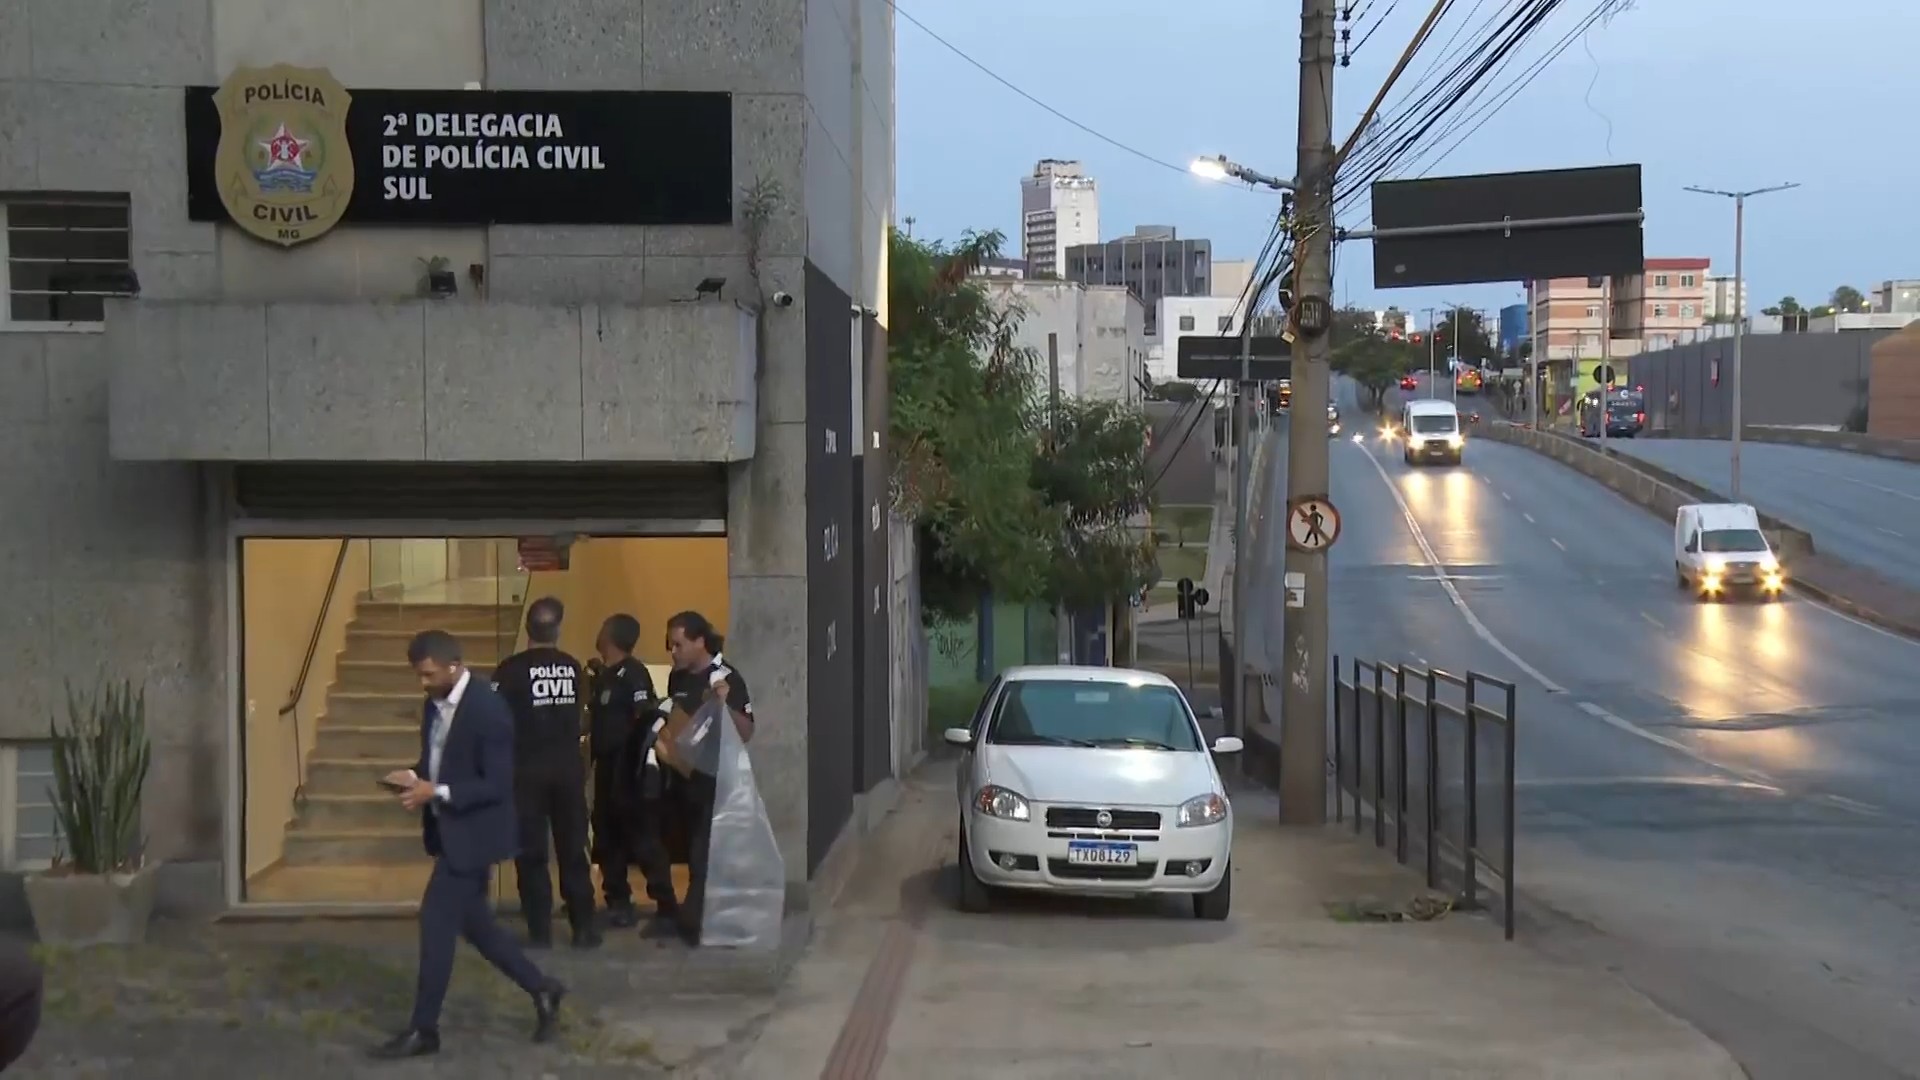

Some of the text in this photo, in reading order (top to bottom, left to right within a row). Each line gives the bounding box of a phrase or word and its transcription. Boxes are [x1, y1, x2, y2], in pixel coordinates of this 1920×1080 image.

[245, 79, 325, 106] POLÍCIA
[383, 113, 564, 137] 2ª DELEGACIA
[383, 139, 606, 169] DE POLÍCIA CIVIL
[384, 176, 433, 200] SUL
[253, 204, 319, 222] CIVIL
[277, 229, 300, 239] MG
[530, 663, 576, 679] POLÍCIA
[532, 679, 576, 697] CIVIL
